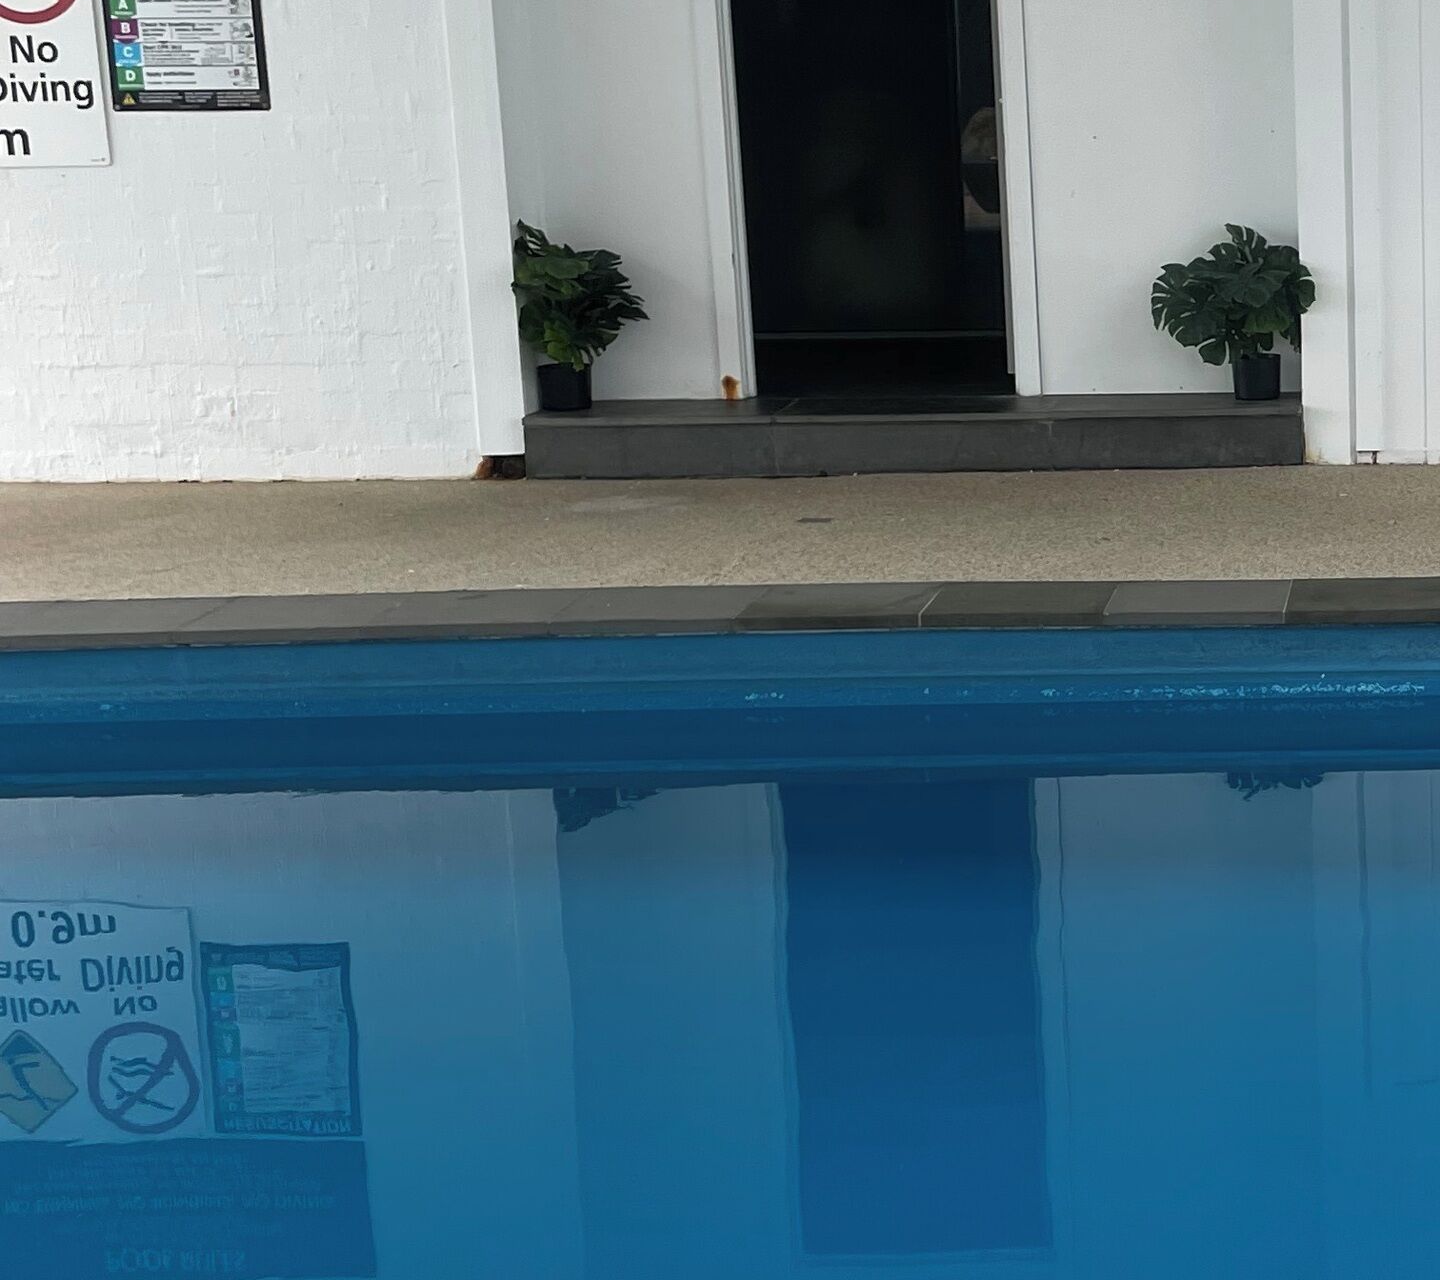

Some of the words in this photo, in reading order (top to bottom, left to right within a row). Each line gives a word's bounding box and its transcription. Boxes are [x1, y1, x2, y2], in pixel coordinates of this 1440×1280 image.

[118, 0, 128, 10] A
[120, 22, 131, 33] B
[10, 35, 58, 63] No
[123, 47, 133, 58] C
[125, 70, 137, 81] D
